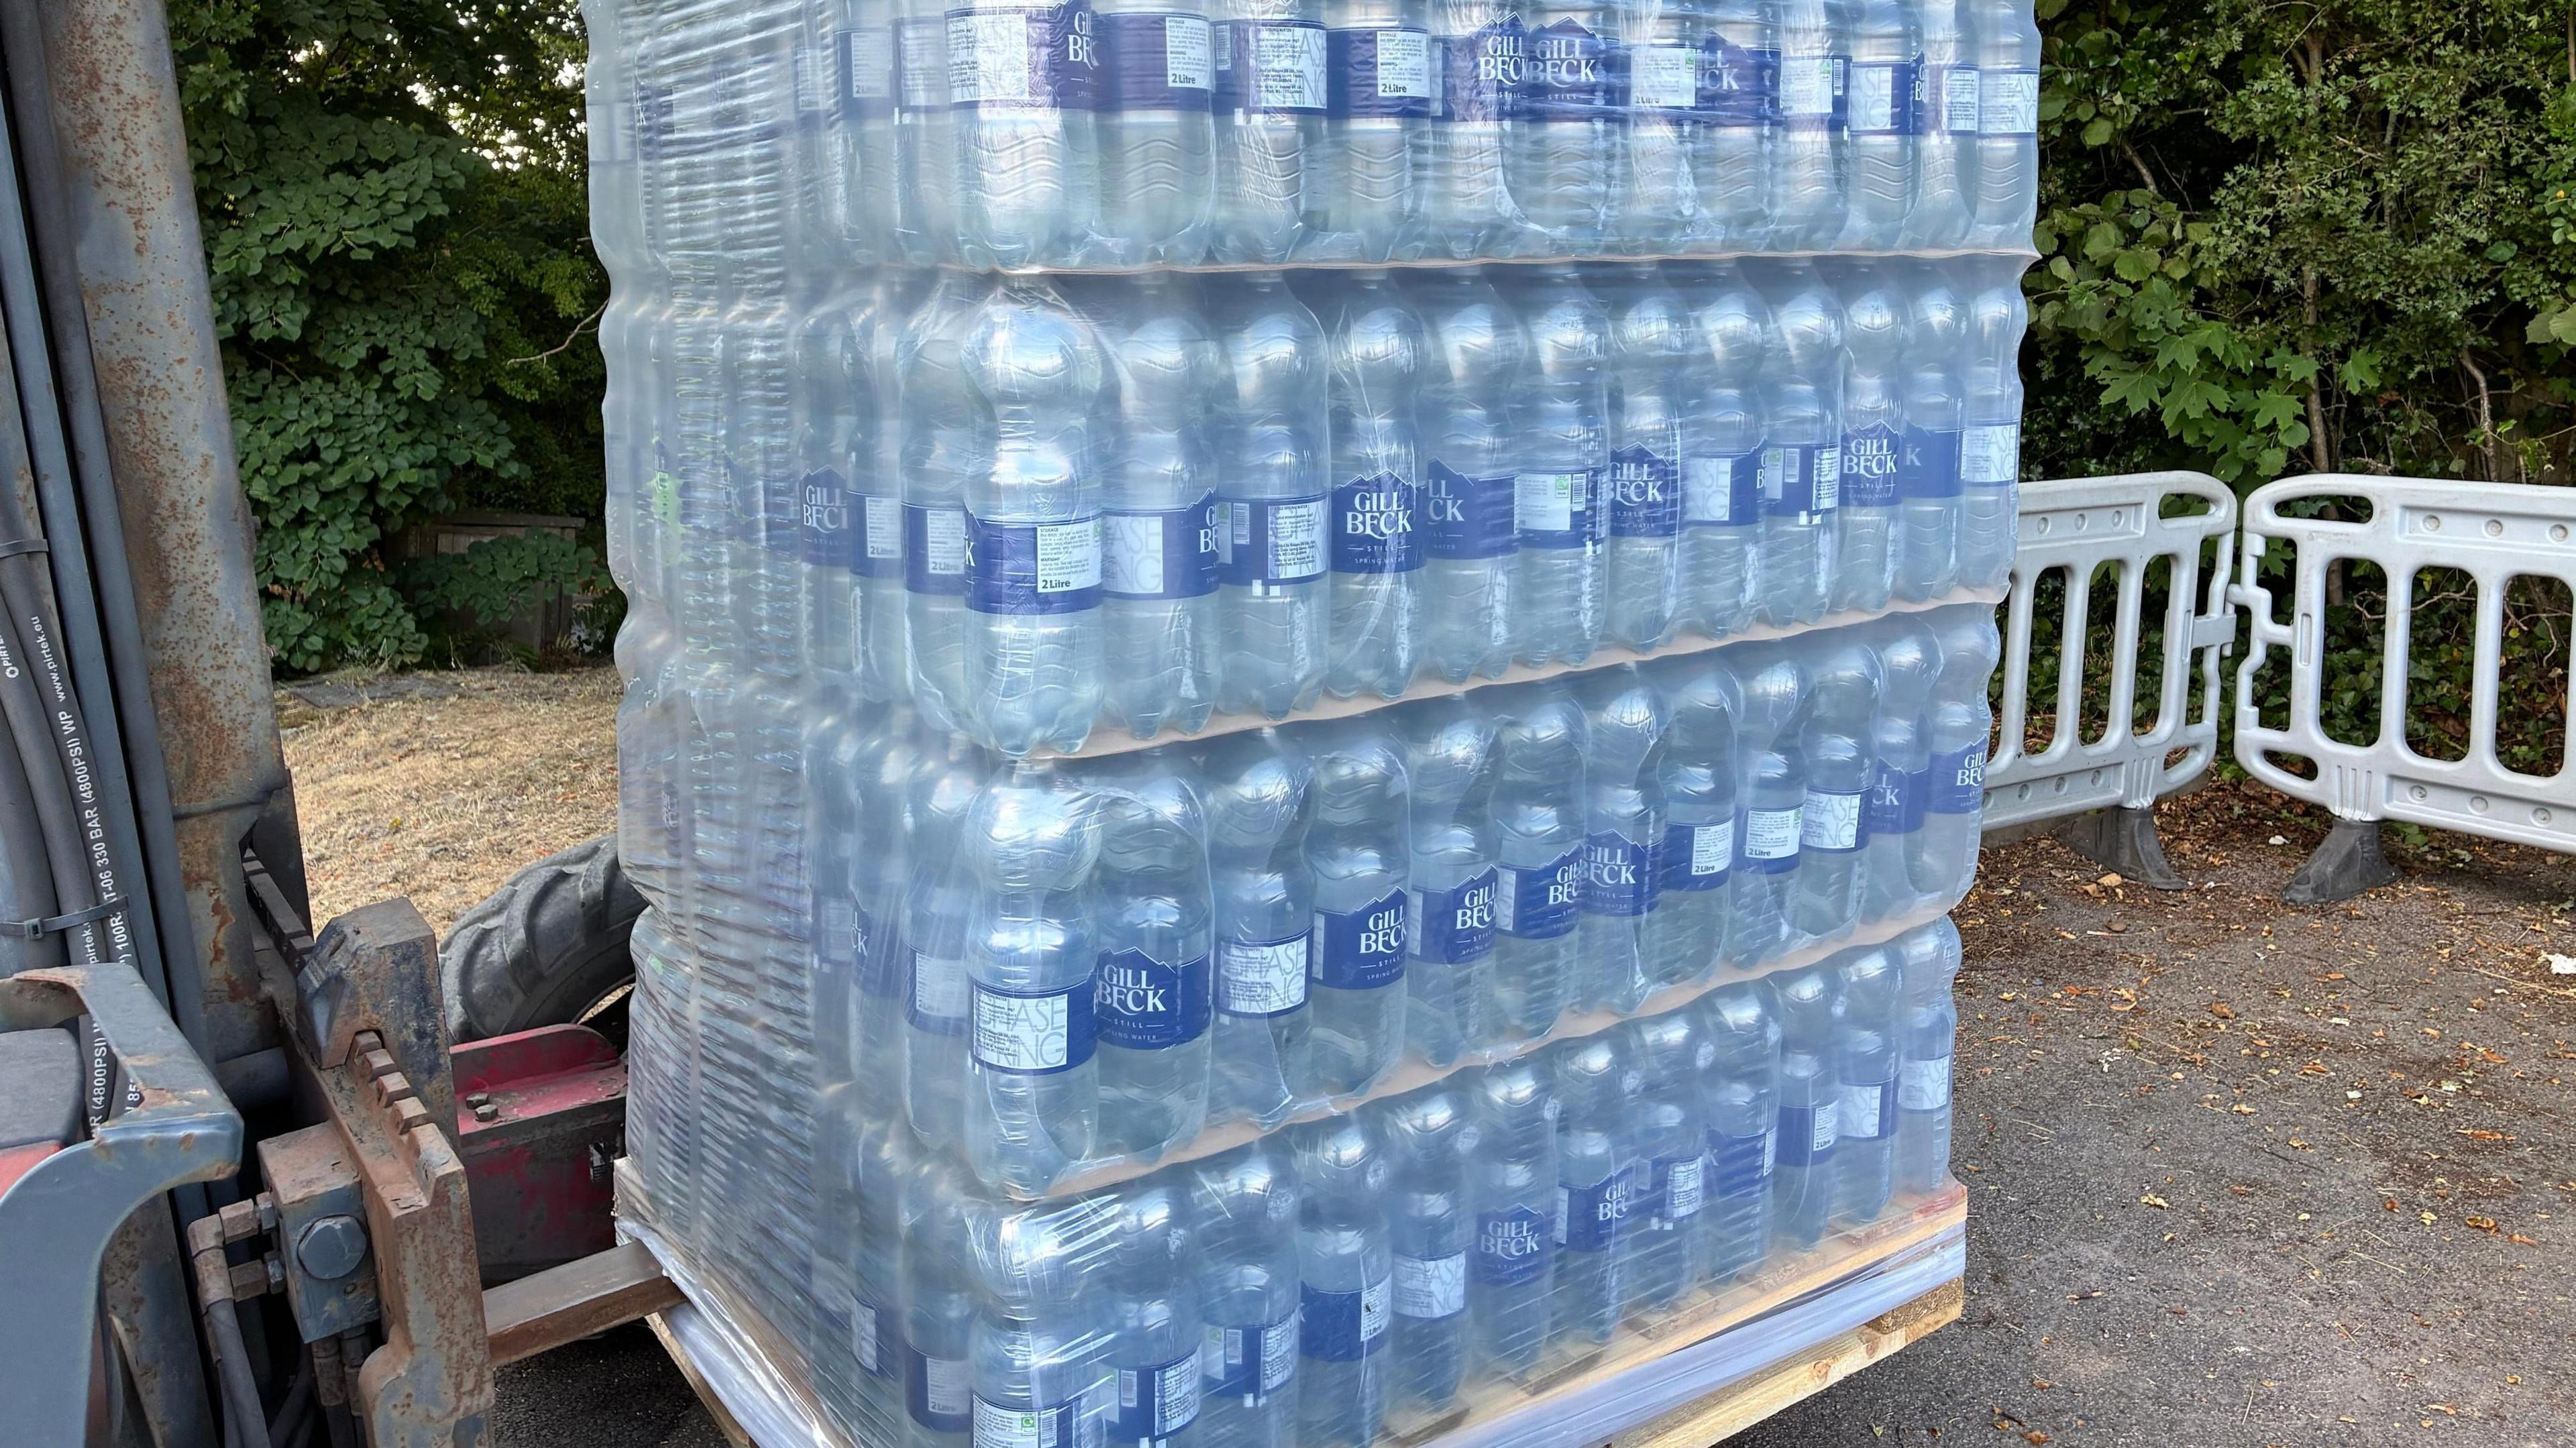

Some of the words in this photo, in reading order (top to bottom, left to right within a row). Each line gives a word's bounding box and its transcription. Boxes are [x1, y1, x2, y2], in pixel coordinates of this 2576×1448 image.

[1487, 36, 1525, 57] GILL
[1535, 40, 1587, 60] GILL
[1172, 73, 1178, 84] 2
[1179, 74, 1196, 85] Litre
[1529, 59, 1596, 87] BECK
[1381, 83, 1388, 93] 2
[1389, 83, 1407, 93] Litre
[1851, 438, 1892, 456] GILL
[1610, 461, 1655, 481] GILL
[1843, 455, 1897, 478] BECK
[806, 485, 847, 507] GILL
[1354, 492, 1404, 512] GILL
[1346, 510, 1413, 539] BECK
[870, 546, 875, 555] 2
[932, 561, 938, 571] 2
[1042, 579, 1049, 589] 2
[1049, 578, 1071, 589] Litre
[30, 616, 66, 702] www.pirtek.eu
[58, 711, 76, 735] WP
[66, 738, 96, 803] (4800PSI)
[85, 806, 103, 840] BAR
[92, 842, 109, 867] 330
[1582, 844, 1628, 865] GILL
[1748, 847, 1754, 855] 2
[1754, 848, 1772, 857] Litre
[1580, 860, 1636, 887] BECK
[1695, 865, 1700, 873] 2
[1701, 864, 1715, 873] Litre
[1464, 882, 1498, 908] GILL
[1368, 905, 1406, 932] GILL
[1379, 955, 1401, 968] STILL
[1104, 964, 1155, 989] GILL
[1098, 980, 1167, 1015] BECK
[1114, 1018, 1143, 1028] STILL
[91, 1038, 107, 1110] (4800PSI)
[1487, 1220, 1533, 1238] GILL
[1481, 1233, 1540, 1260] BECK
